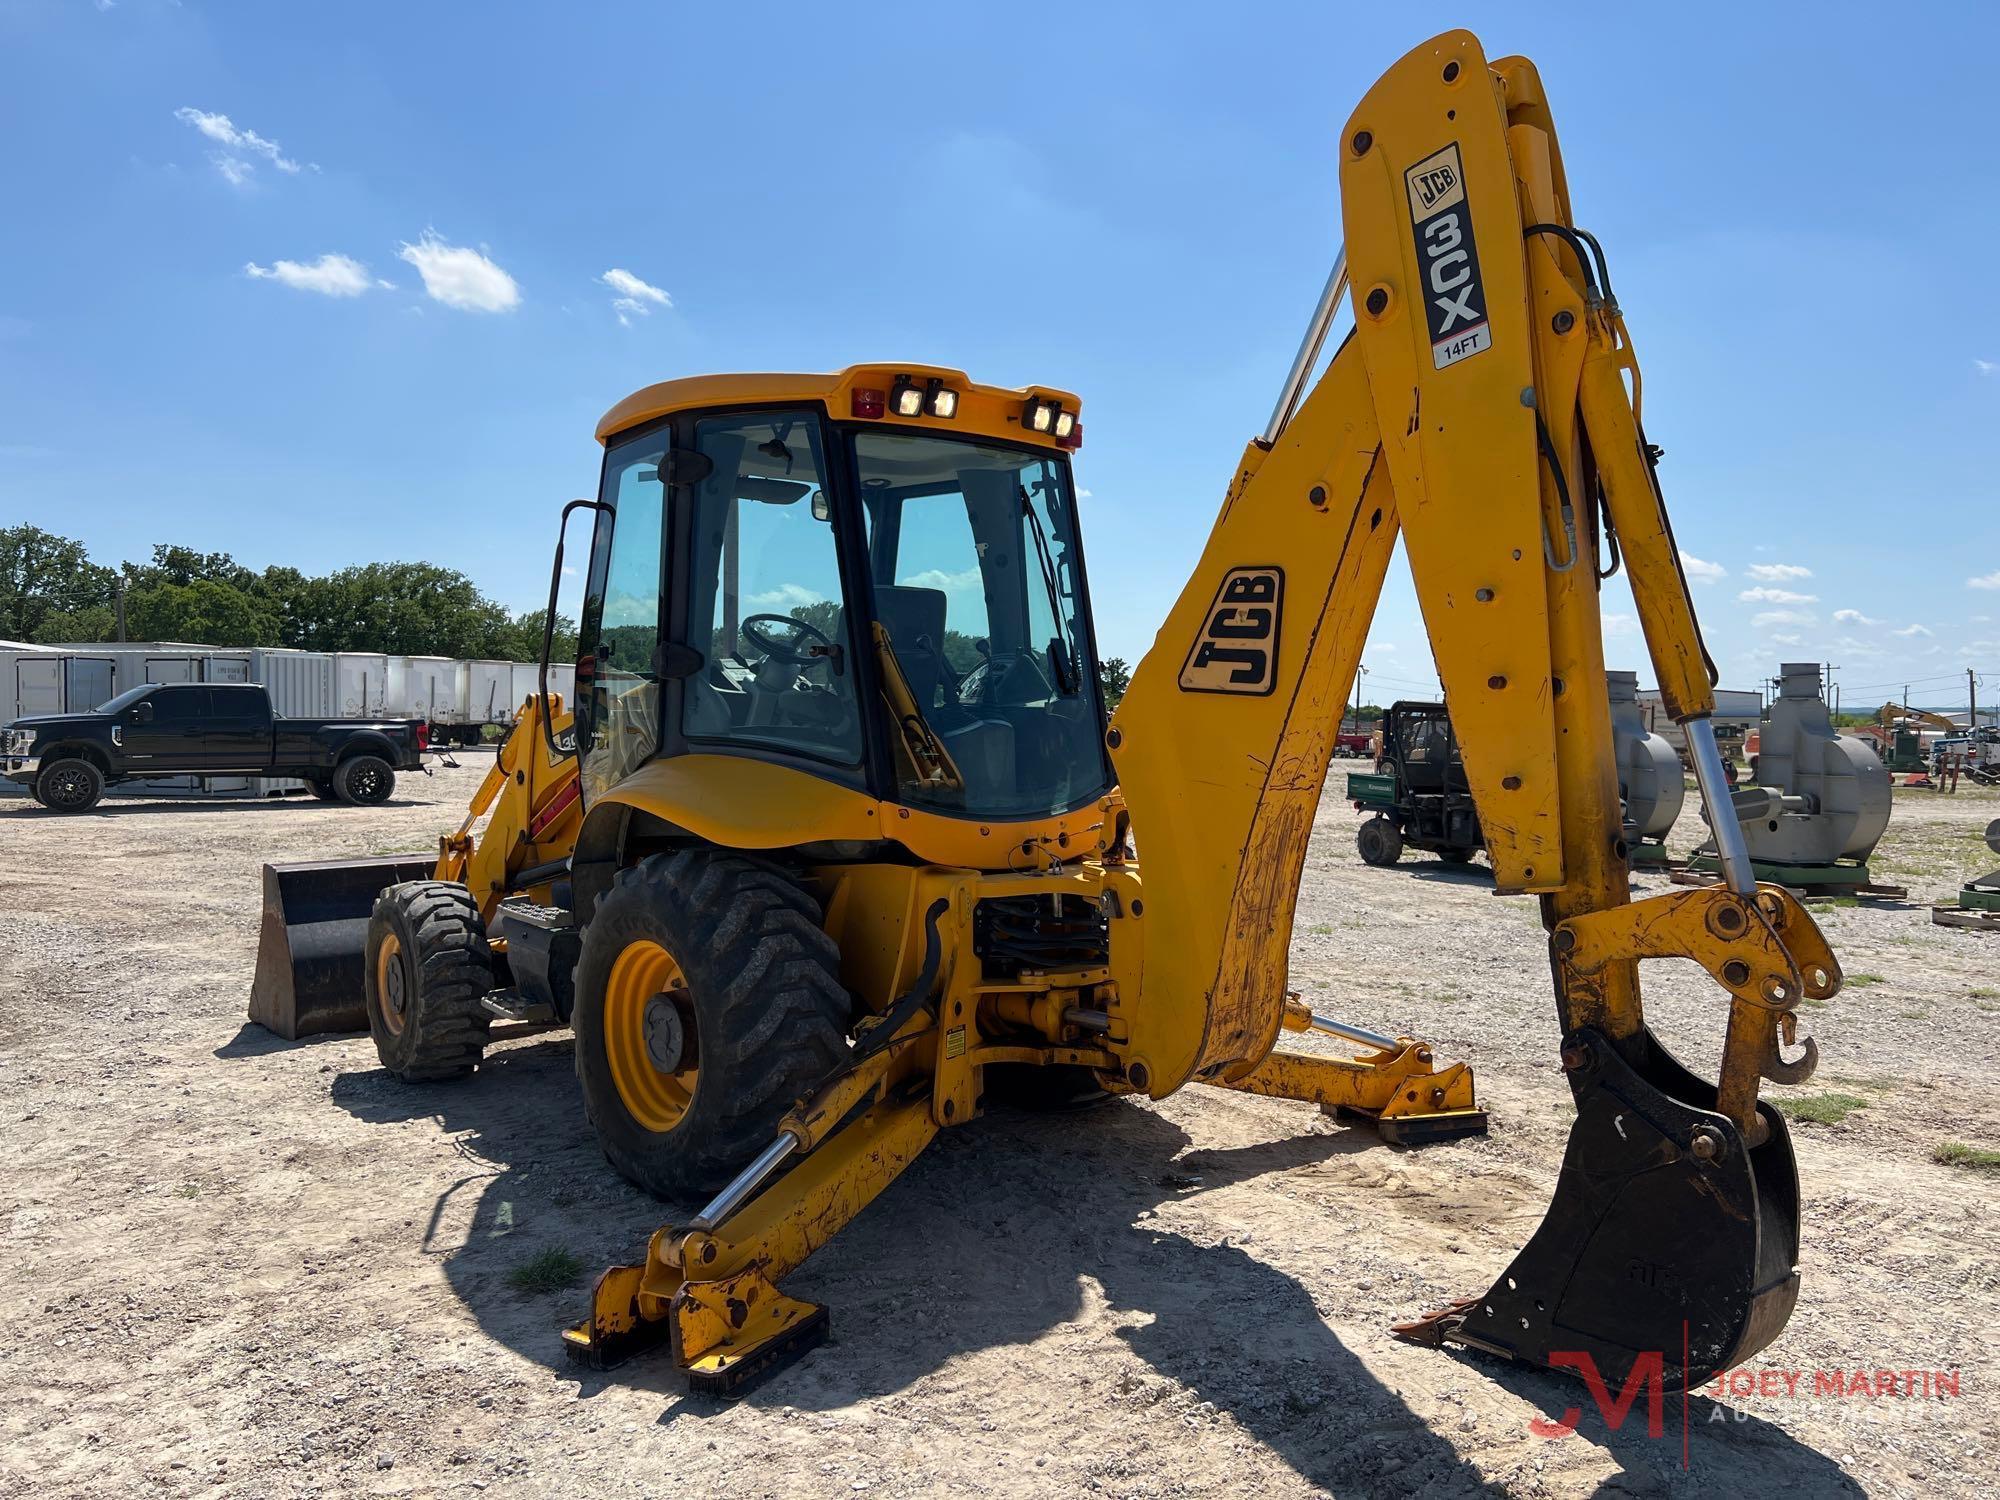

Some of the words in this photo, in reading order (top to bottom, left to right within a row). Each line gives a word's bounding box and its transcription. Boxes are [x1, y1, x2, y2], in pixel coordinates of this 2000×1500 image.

[1420, 168, 1454, 204] JCB
[1425, 213, 1480, 334] 3CX
[1444, 333, 1479, 360] 14FT
[1192, 576, 1275, 684] JCB
